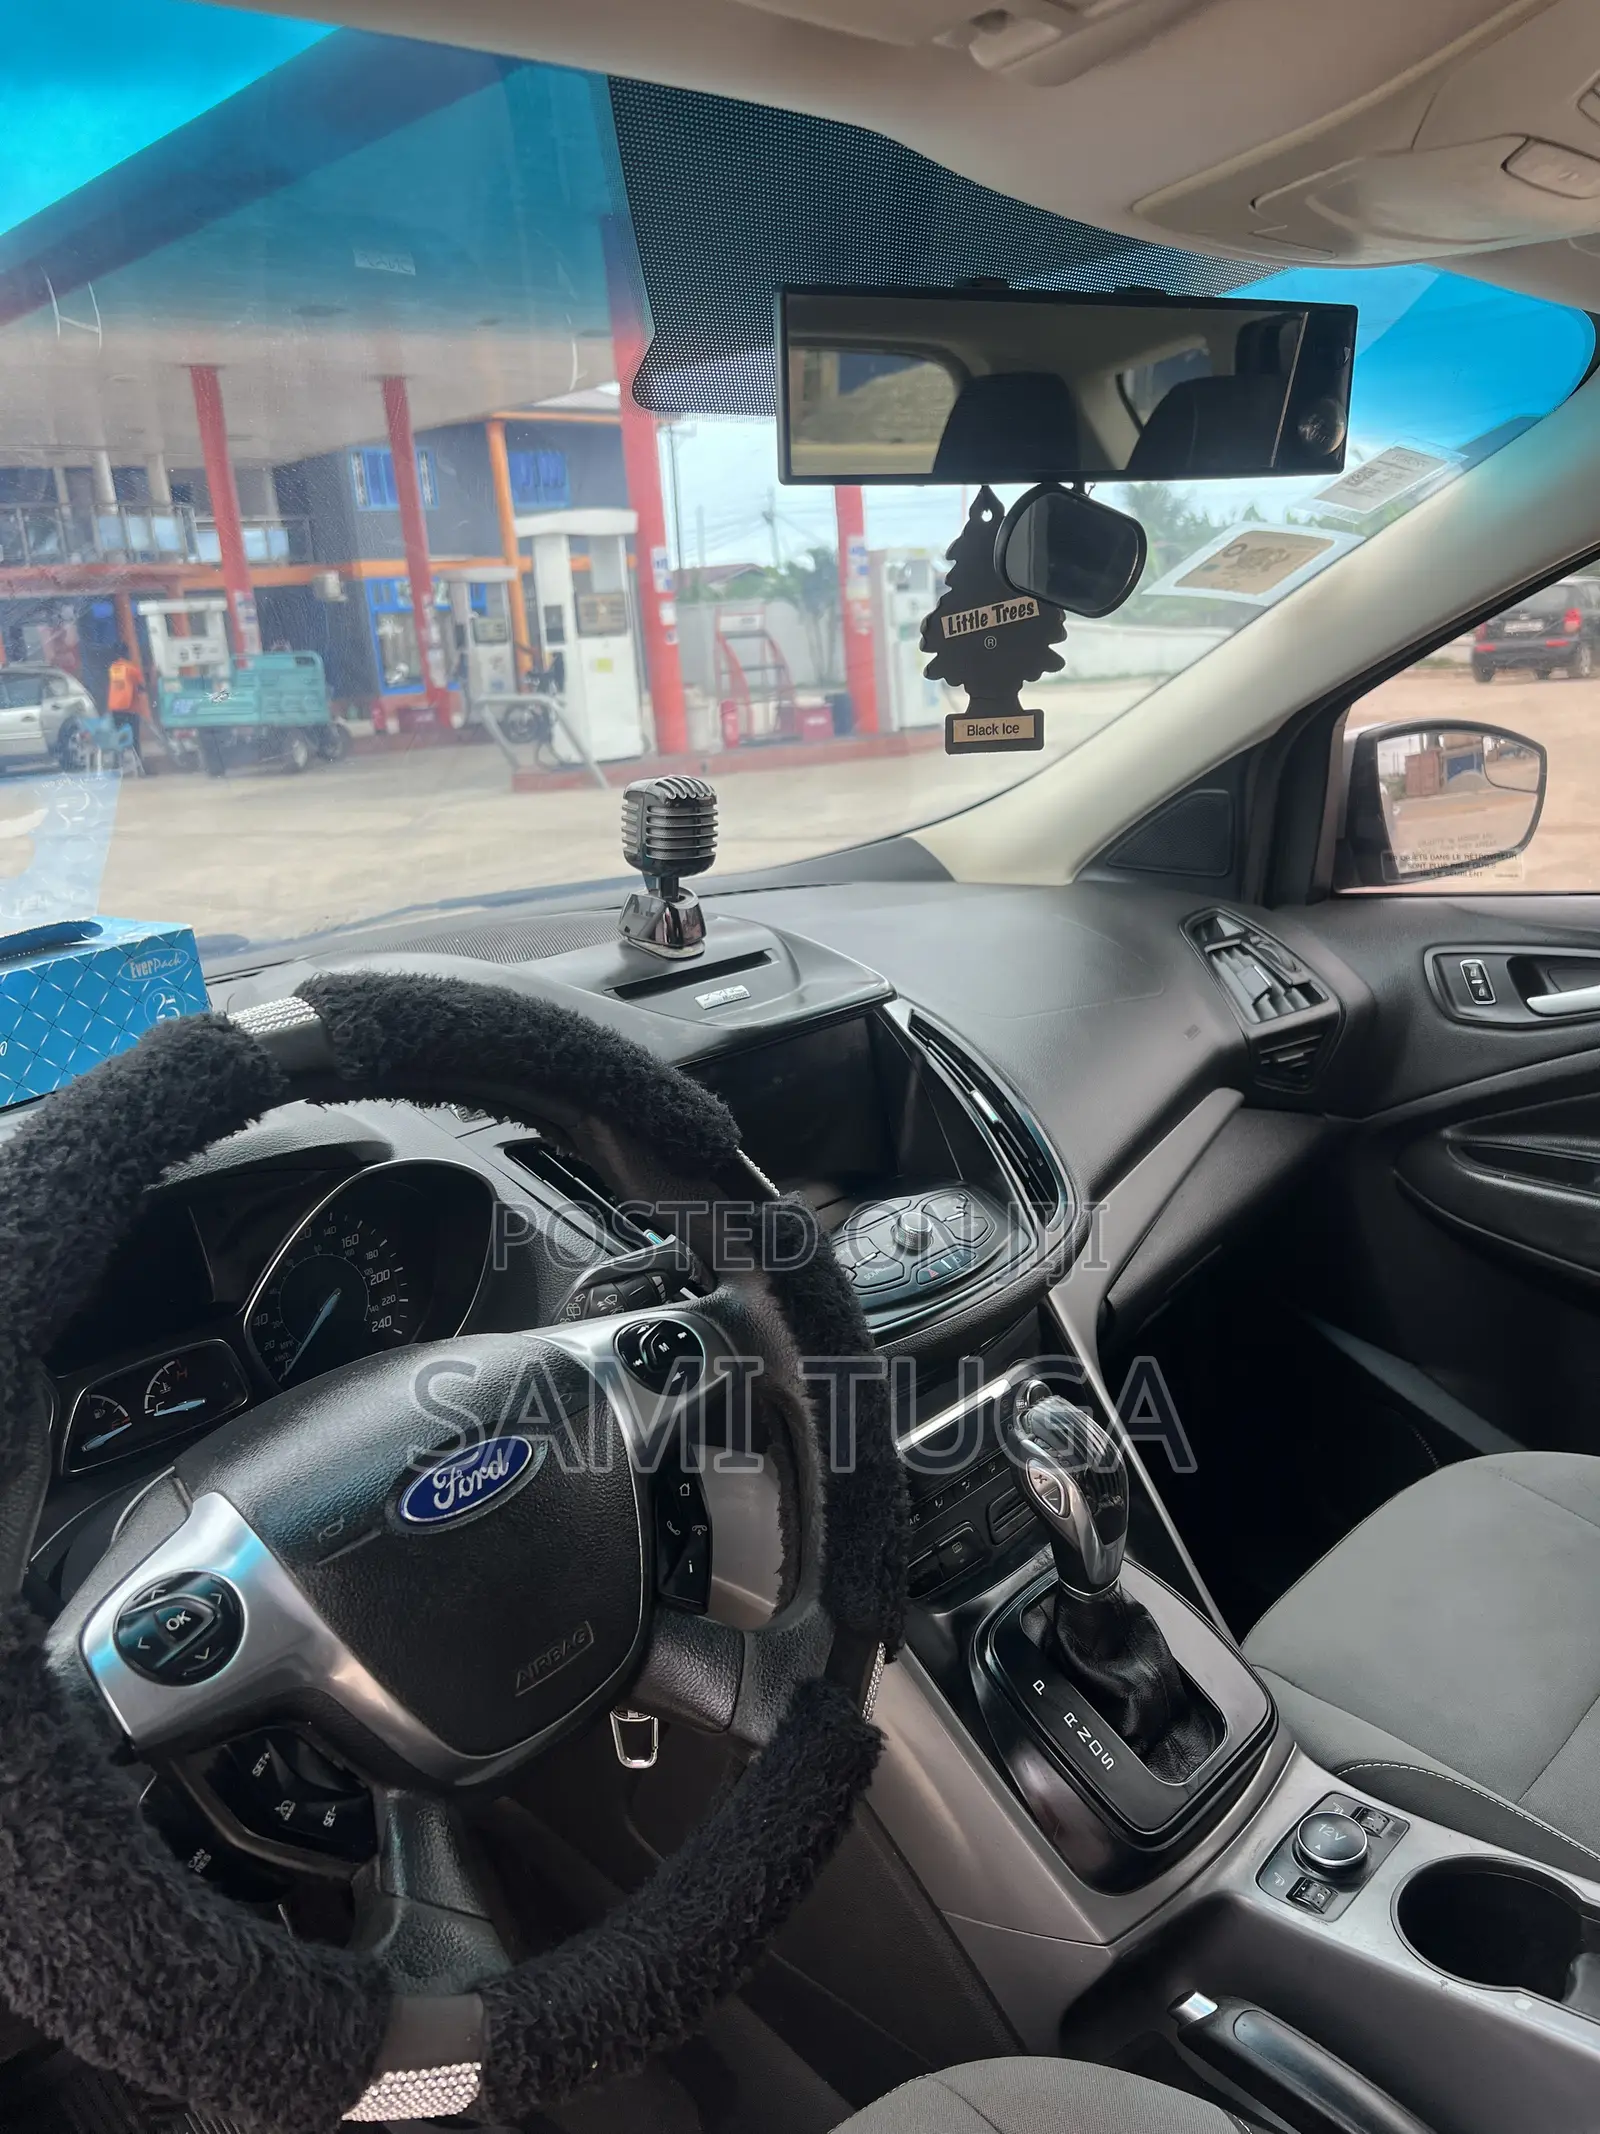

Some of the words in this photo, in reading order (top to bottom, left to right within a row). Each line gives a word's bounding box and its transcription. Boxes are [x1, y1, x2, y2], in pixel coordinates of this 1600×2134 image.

[947, 611, 989, 635] Little
[992, 601, 1035, 624] Trees
[967, 724, 999, 736] Black
[1002, 723, 1020, 734] Ice
[130, 952, 181, 979] EverPack
[341, 1233, 360, 1249] 160
[365, 1249, 379, 1260] 180
[370, 1269, 391, 1286] 200
[381, 1294, 396, 1306] 220
[371, 1315, 392, 1333] 240
[432, 1448, 510, 1510] Ford
[908, 1513, 921, 1526] A/C
[166, 1610, 192, 1631] OK
[516, 1629, 588, 1688] AIRBAG
[1032, 1680, 1045, 1696] P
[1063, 1712, 1078, 1728] R
[1076, 1726, 1092, 1743] N
[1088, 1739, 1103, 1757] D
[1101, 1752, 1115, 1770] S
[1317, 1823, 1347, 1841] 12V
